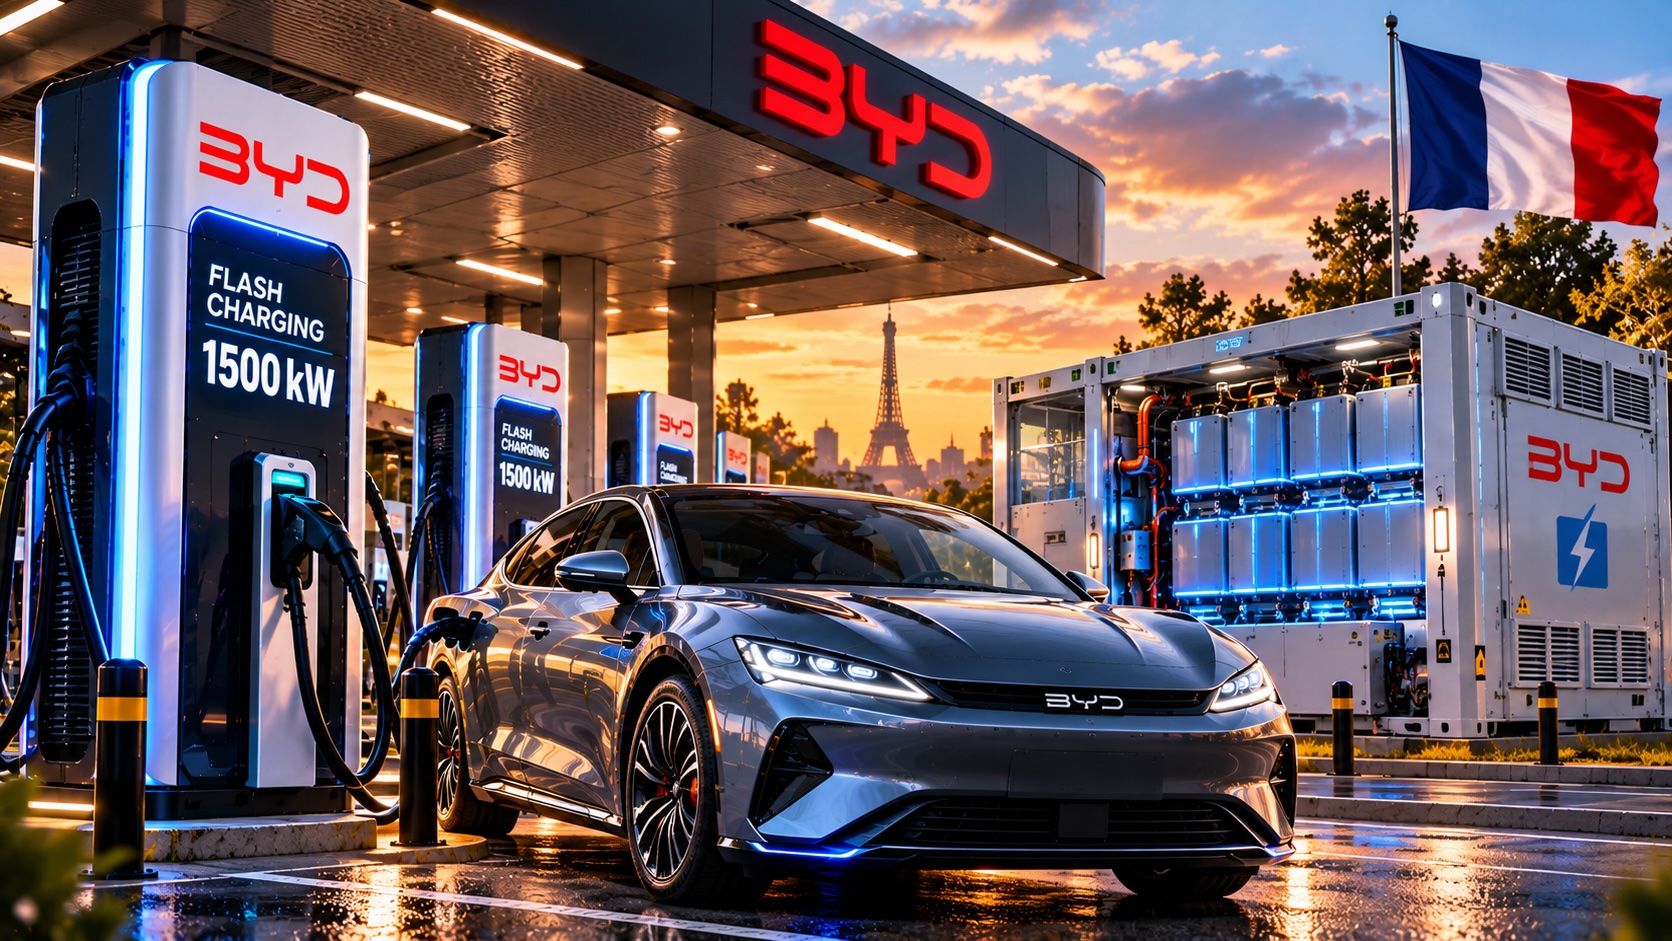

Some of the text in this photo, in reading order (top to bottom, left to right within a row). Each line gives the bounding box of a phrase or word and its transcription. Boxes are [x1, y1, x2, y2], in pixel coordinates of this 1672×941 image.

[760, 18, 992, 199] BYD
[199, 121, 350, 215] BYD
[209, 263, 283, 304] FLASH
[207, 292, 325, 343] CHARGING
[202, 339, 335, 408] 1500 kW
[499, 354, 561, 393] BYD
[502, 423, 533, 441] FLASH
[659, 413, 694, 438] BYD
[501, 437, 550, 460] CHARGING
[1527, 434, 1631, 495] BYD
[499, 461, 556, 495] 1500 kW
[1045, 693, 1124, 710] BYD
